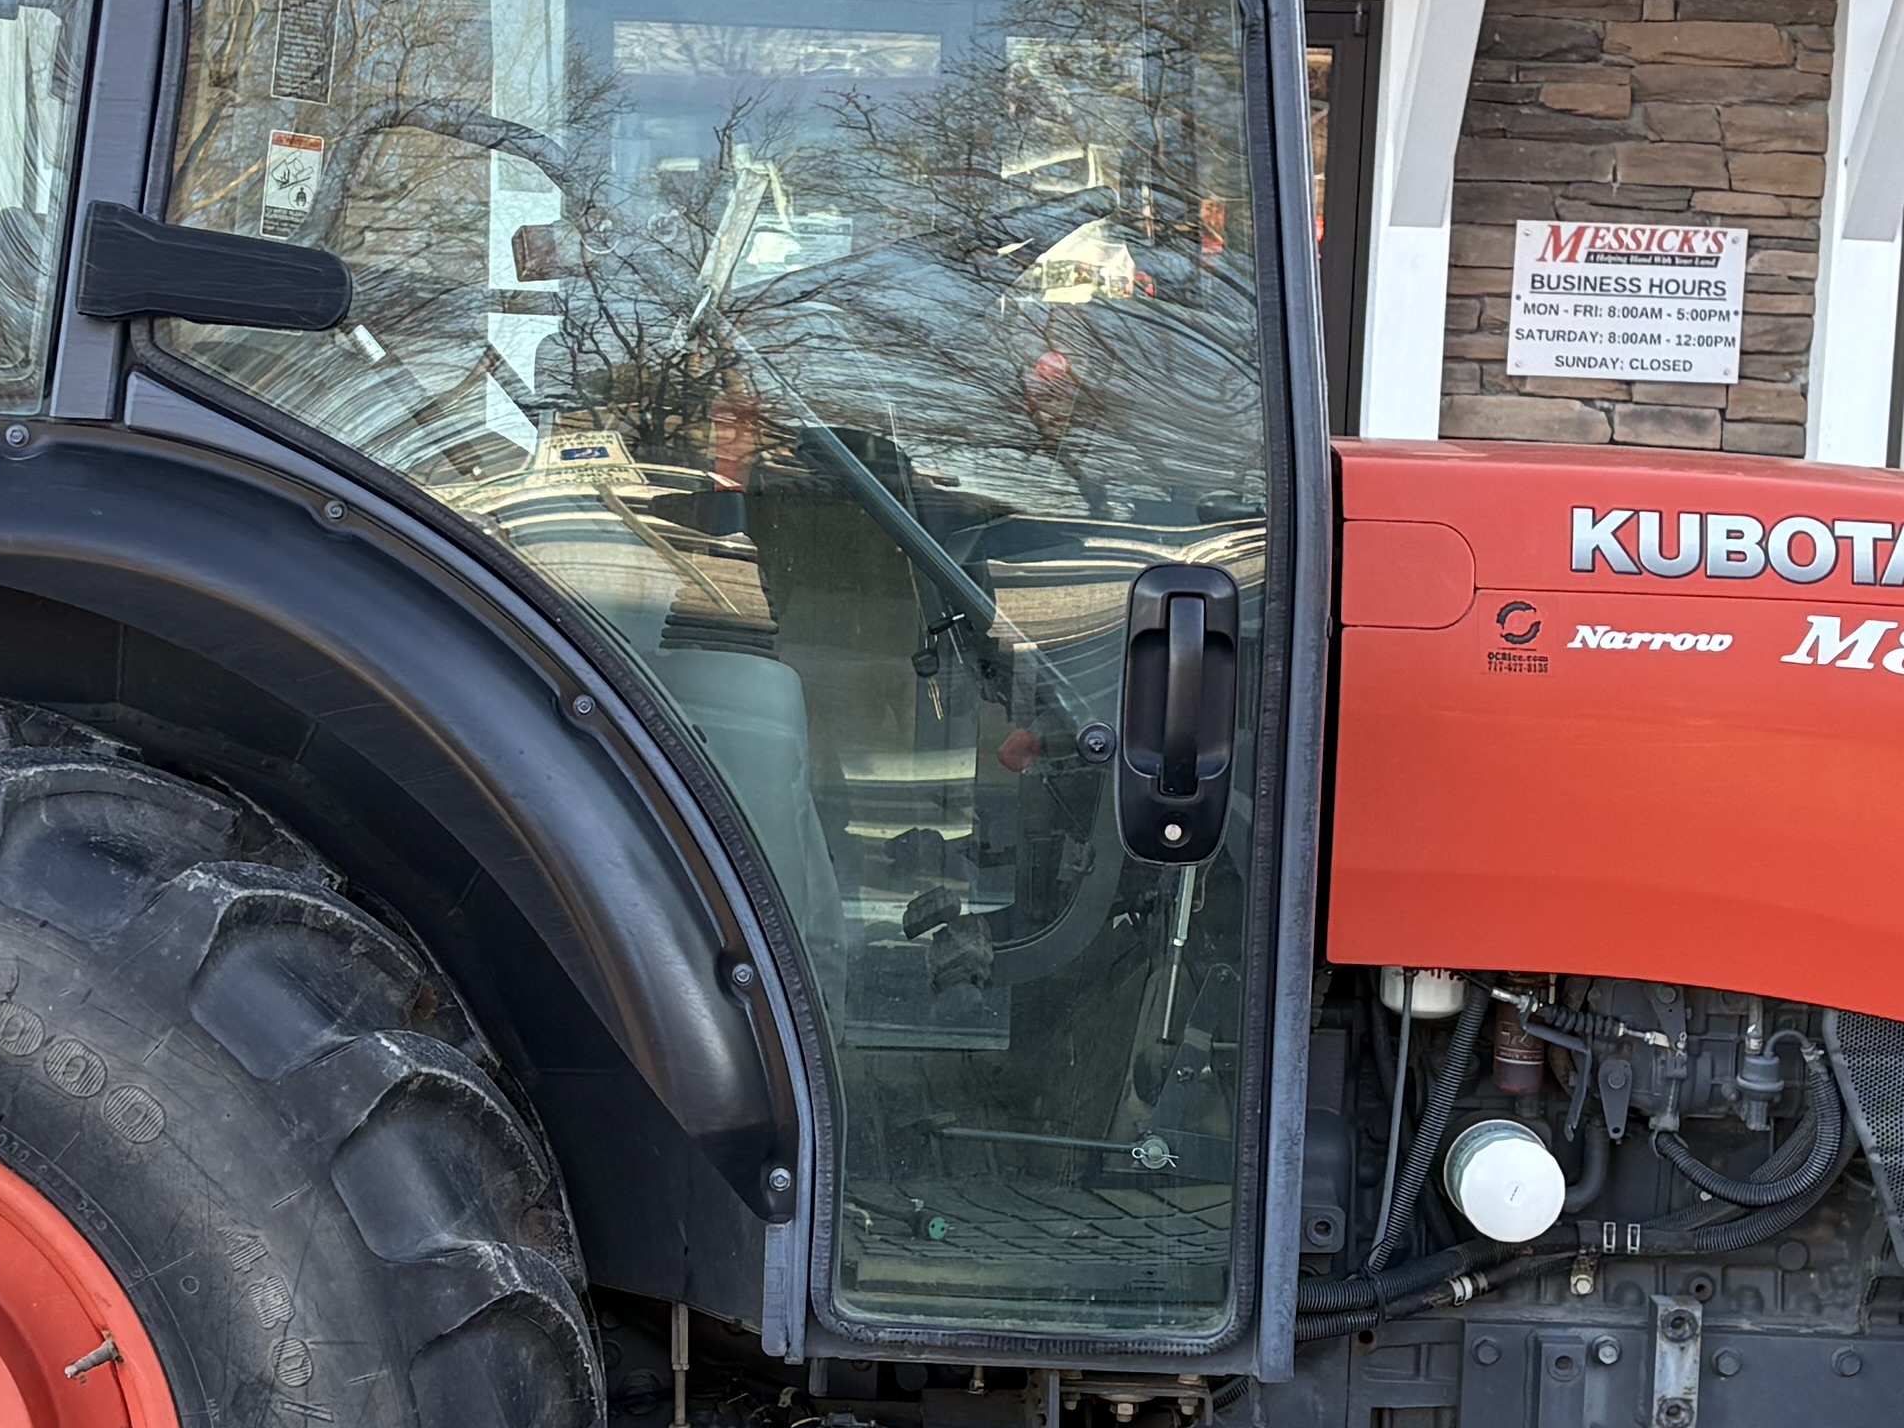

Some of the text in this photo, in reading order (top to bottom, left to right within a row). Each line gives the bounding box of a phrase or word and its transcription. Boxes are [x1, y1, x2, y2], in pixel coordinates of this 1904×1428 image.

[1536, 224, 1728, 264] MESSICK'S
[1530, 273, 1727, 297] BUSINESS HOURS
[1523, 302, 1559, 317] MON
[1573, 304, 1603, 318] FRI:
[1607, 305, 1663, 320] 8:00AM
[1676, 308, 1731, 322] 5:00PM
[1514, 328, 1604, 345] SATURDAY:
[1607, 332, 1662, 346] 8:00AM
[1674, 334, 1736, 348] 12:00PM
[1554, 355, 1693, 373] SUNDAY: CLOSED
[1567, 624, 1733, 653] Narrow
